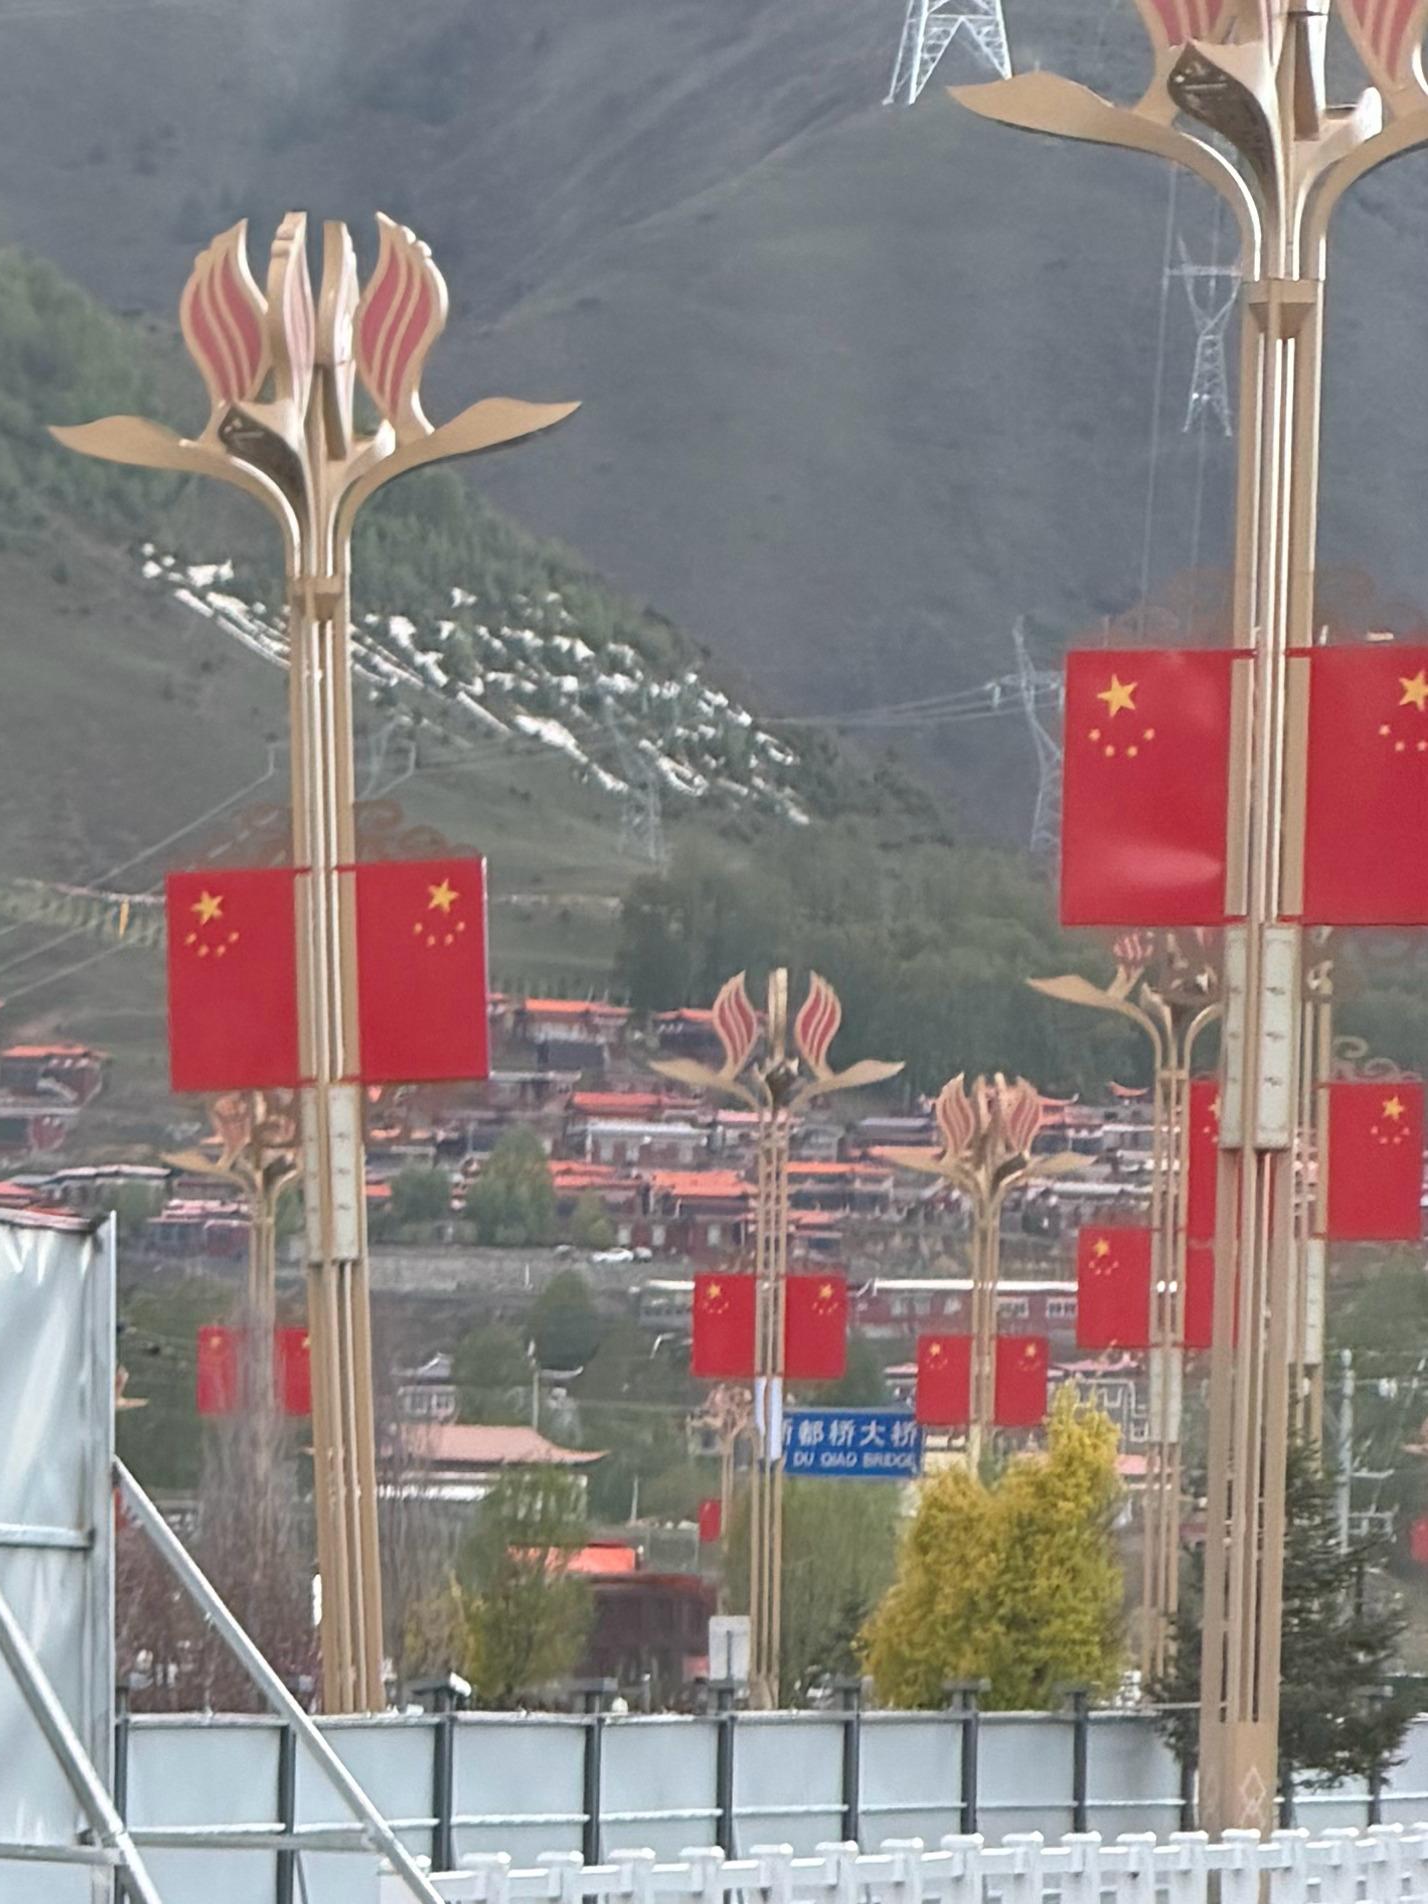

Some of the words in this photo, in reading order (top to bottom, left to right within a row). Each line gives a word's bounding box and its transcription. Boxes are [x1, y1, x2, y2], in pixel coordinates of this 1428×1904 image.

[793, 1451, 816, 1467] DU
[820, 1451, 858, 1468] QIAO
[863, 1452, 918, 1470] BRIDGE
